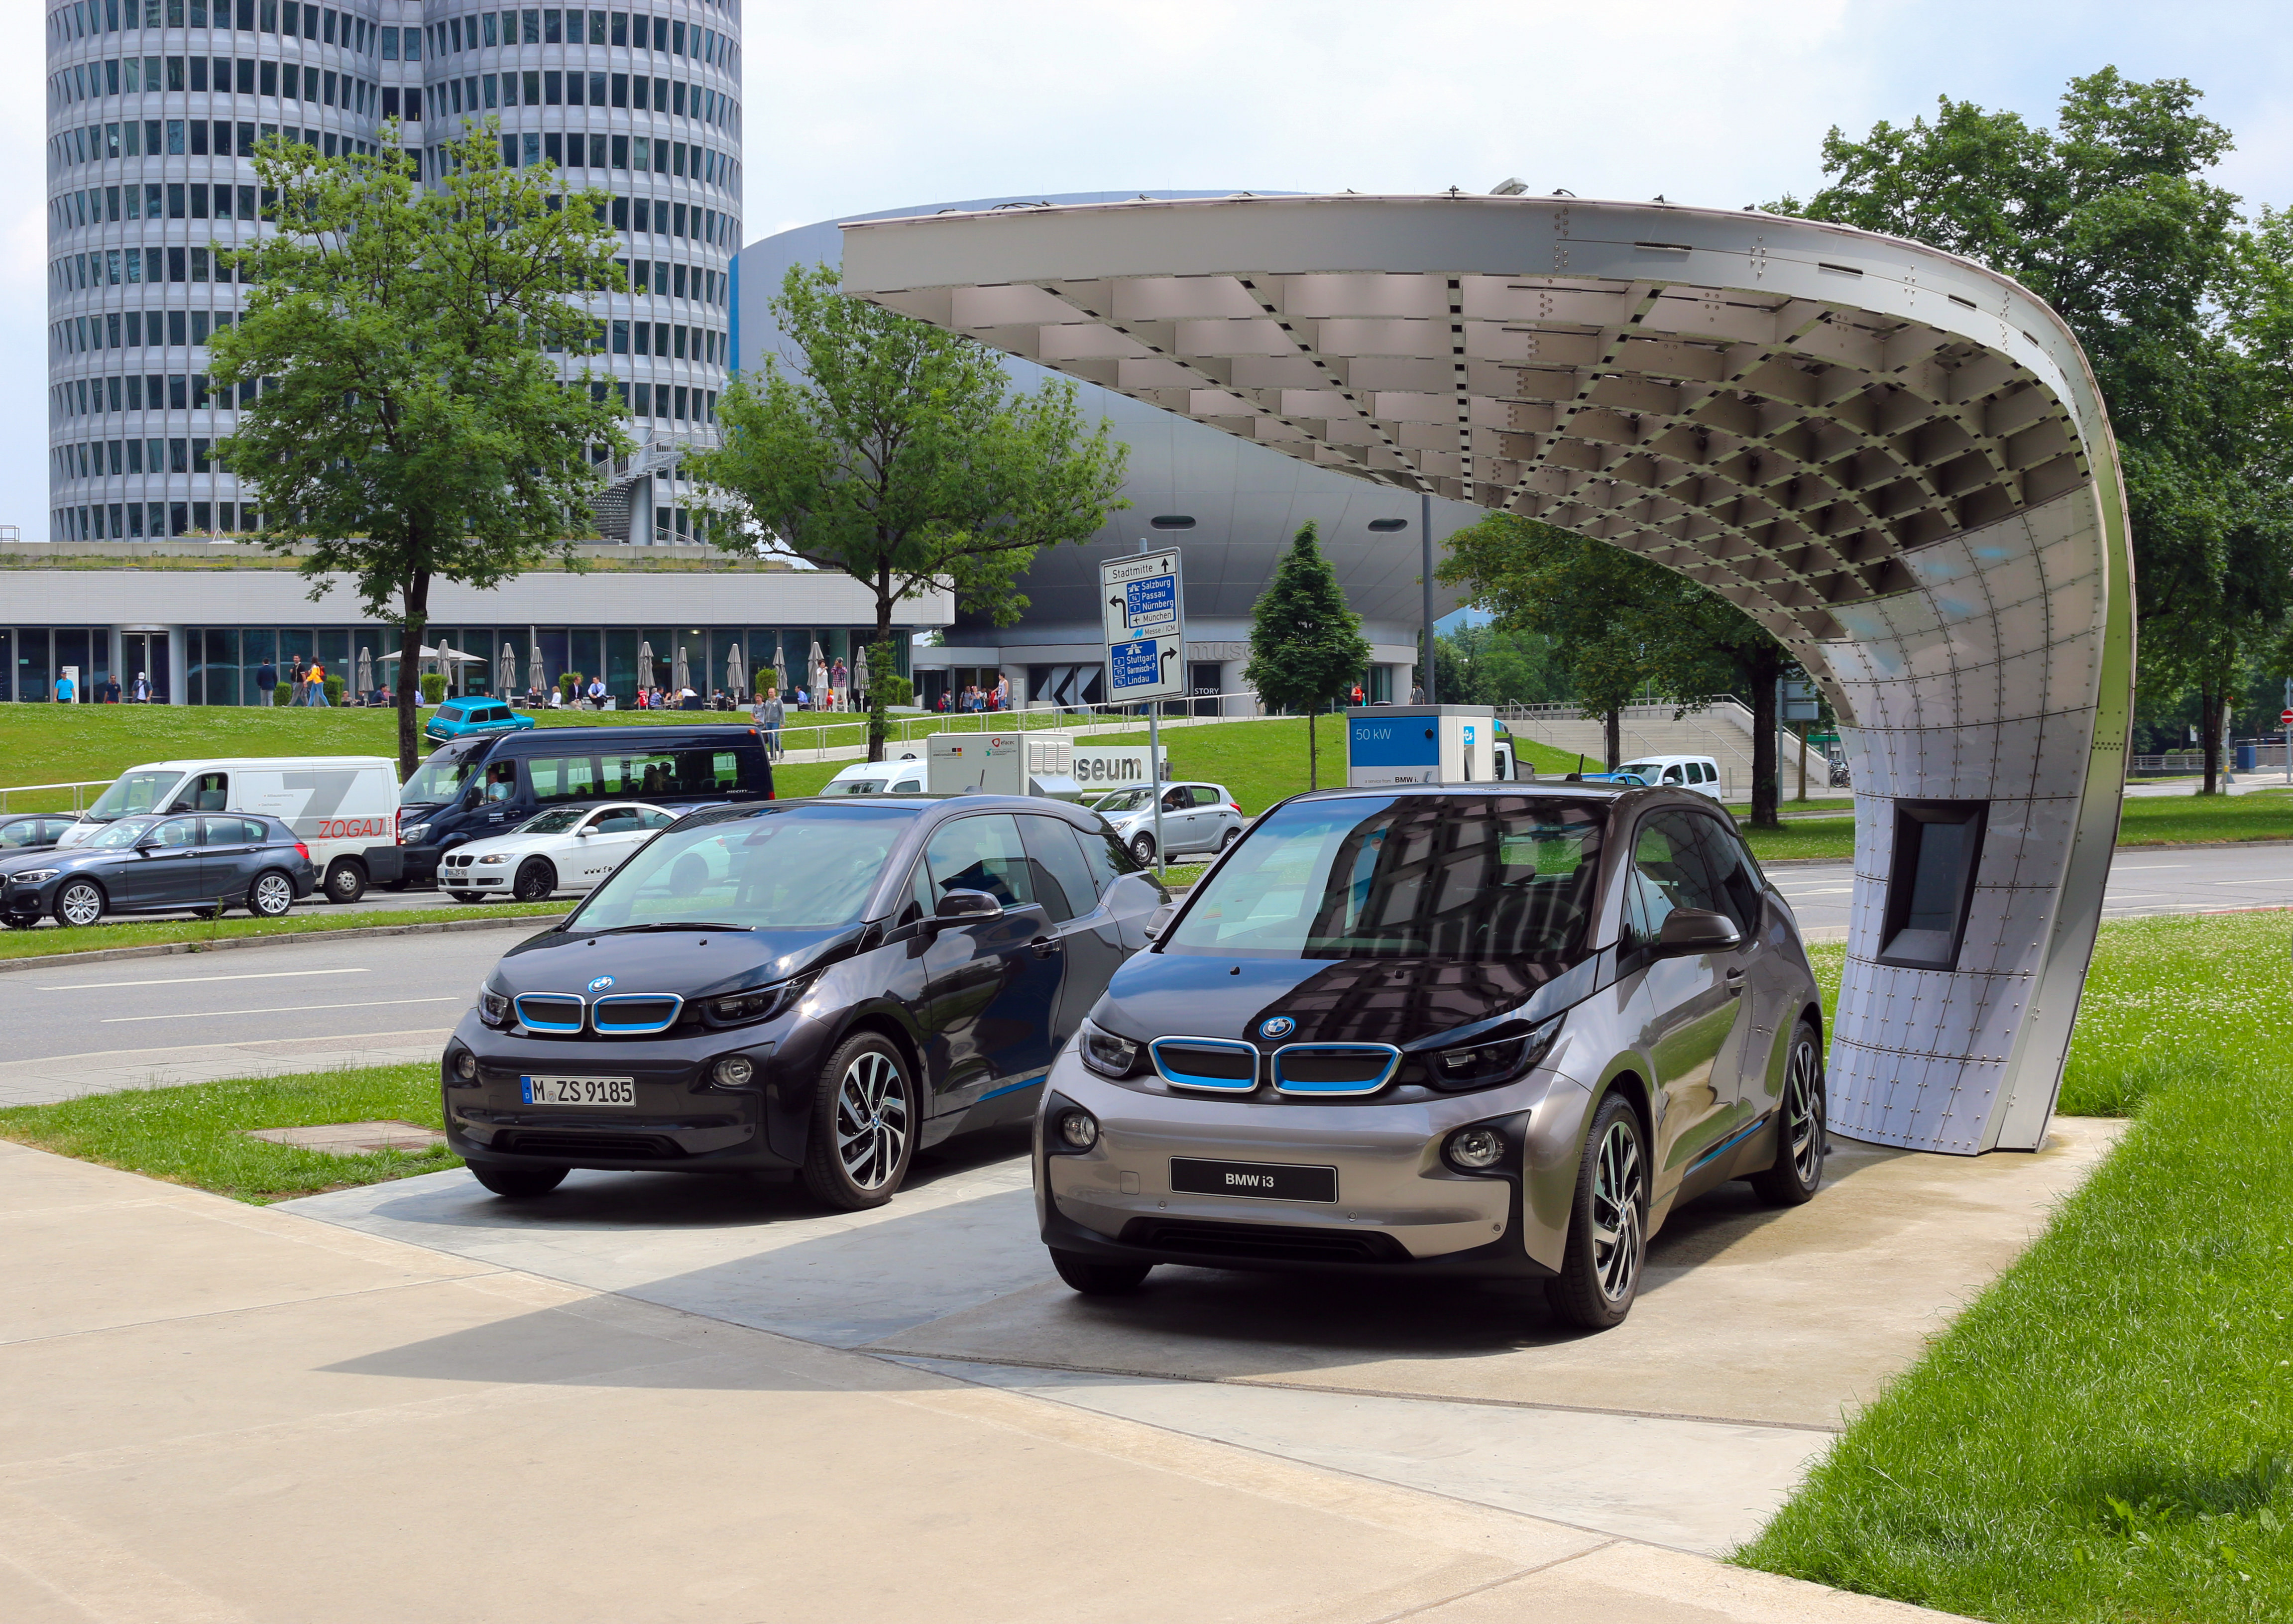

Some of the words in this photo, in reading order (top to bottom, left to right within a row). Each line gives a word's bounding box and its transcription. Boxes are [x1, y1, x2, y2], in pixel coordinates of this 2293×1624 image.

[1113, 564, 1153, 579] Stadtmitte
[1142, 580, 1171, 590] Salzburg
[1142, 591, 1166, 600] Passau
[1143, 599, 1174, 611] Nürnberg
[1143, 612, 1171, 622] München
[1127, 653, 1155, 665] Stuttgart
[1127, 663, 1156, 675] Garmisch-P.
[1128, 675, 1149, 685] Lindau
[1356, 728, 1370, 740] 50
[1374, 728, 1391, 740] kW
[318, 818, 384, 838] ZOGAJ
[584, 865, 615, 875] www.fe
[533, 1080, 546, 1101] M
[556, 1080, 581, 1102] ZS
[585, 1081, 632, 1103] 9185
[1226, 1173, 1260, 1186] BMW
[1262, 1175, 1274, 1187] i3
